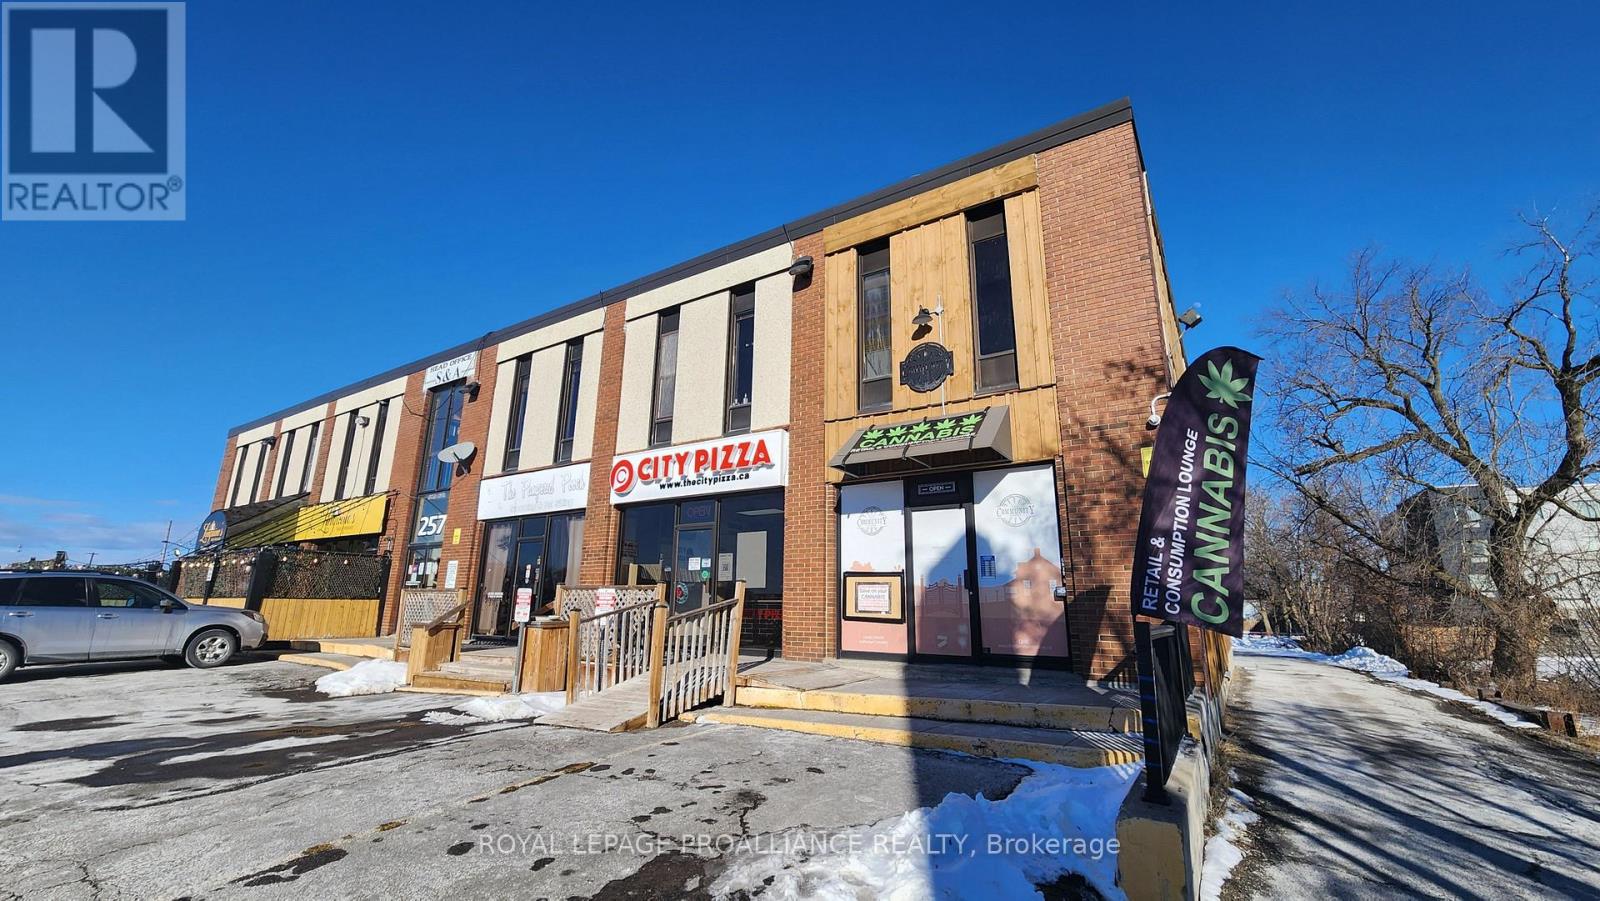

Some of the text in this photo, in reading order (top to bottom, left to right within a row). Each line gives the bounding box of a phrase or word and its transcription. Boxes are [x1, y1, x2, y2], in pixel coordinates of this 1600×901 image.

[430, 353, 473, 373] HEAD OFFICE
[858, 424, 976, 449] CANNABIS
[637, 438, 772, 482] CITY PIZZA
[659, 472, 750, 490] www.thecitypizza.ca
[928, 485, 945, 493] OPEN
[418, 513, 448, 537] 257
[1165, 427, 1198, 615] CONSUMPTION LOUNGE
[1190, 412, 1239, 624] CANNABIS
[1142, 536, 1165, 611] RETAIL &
